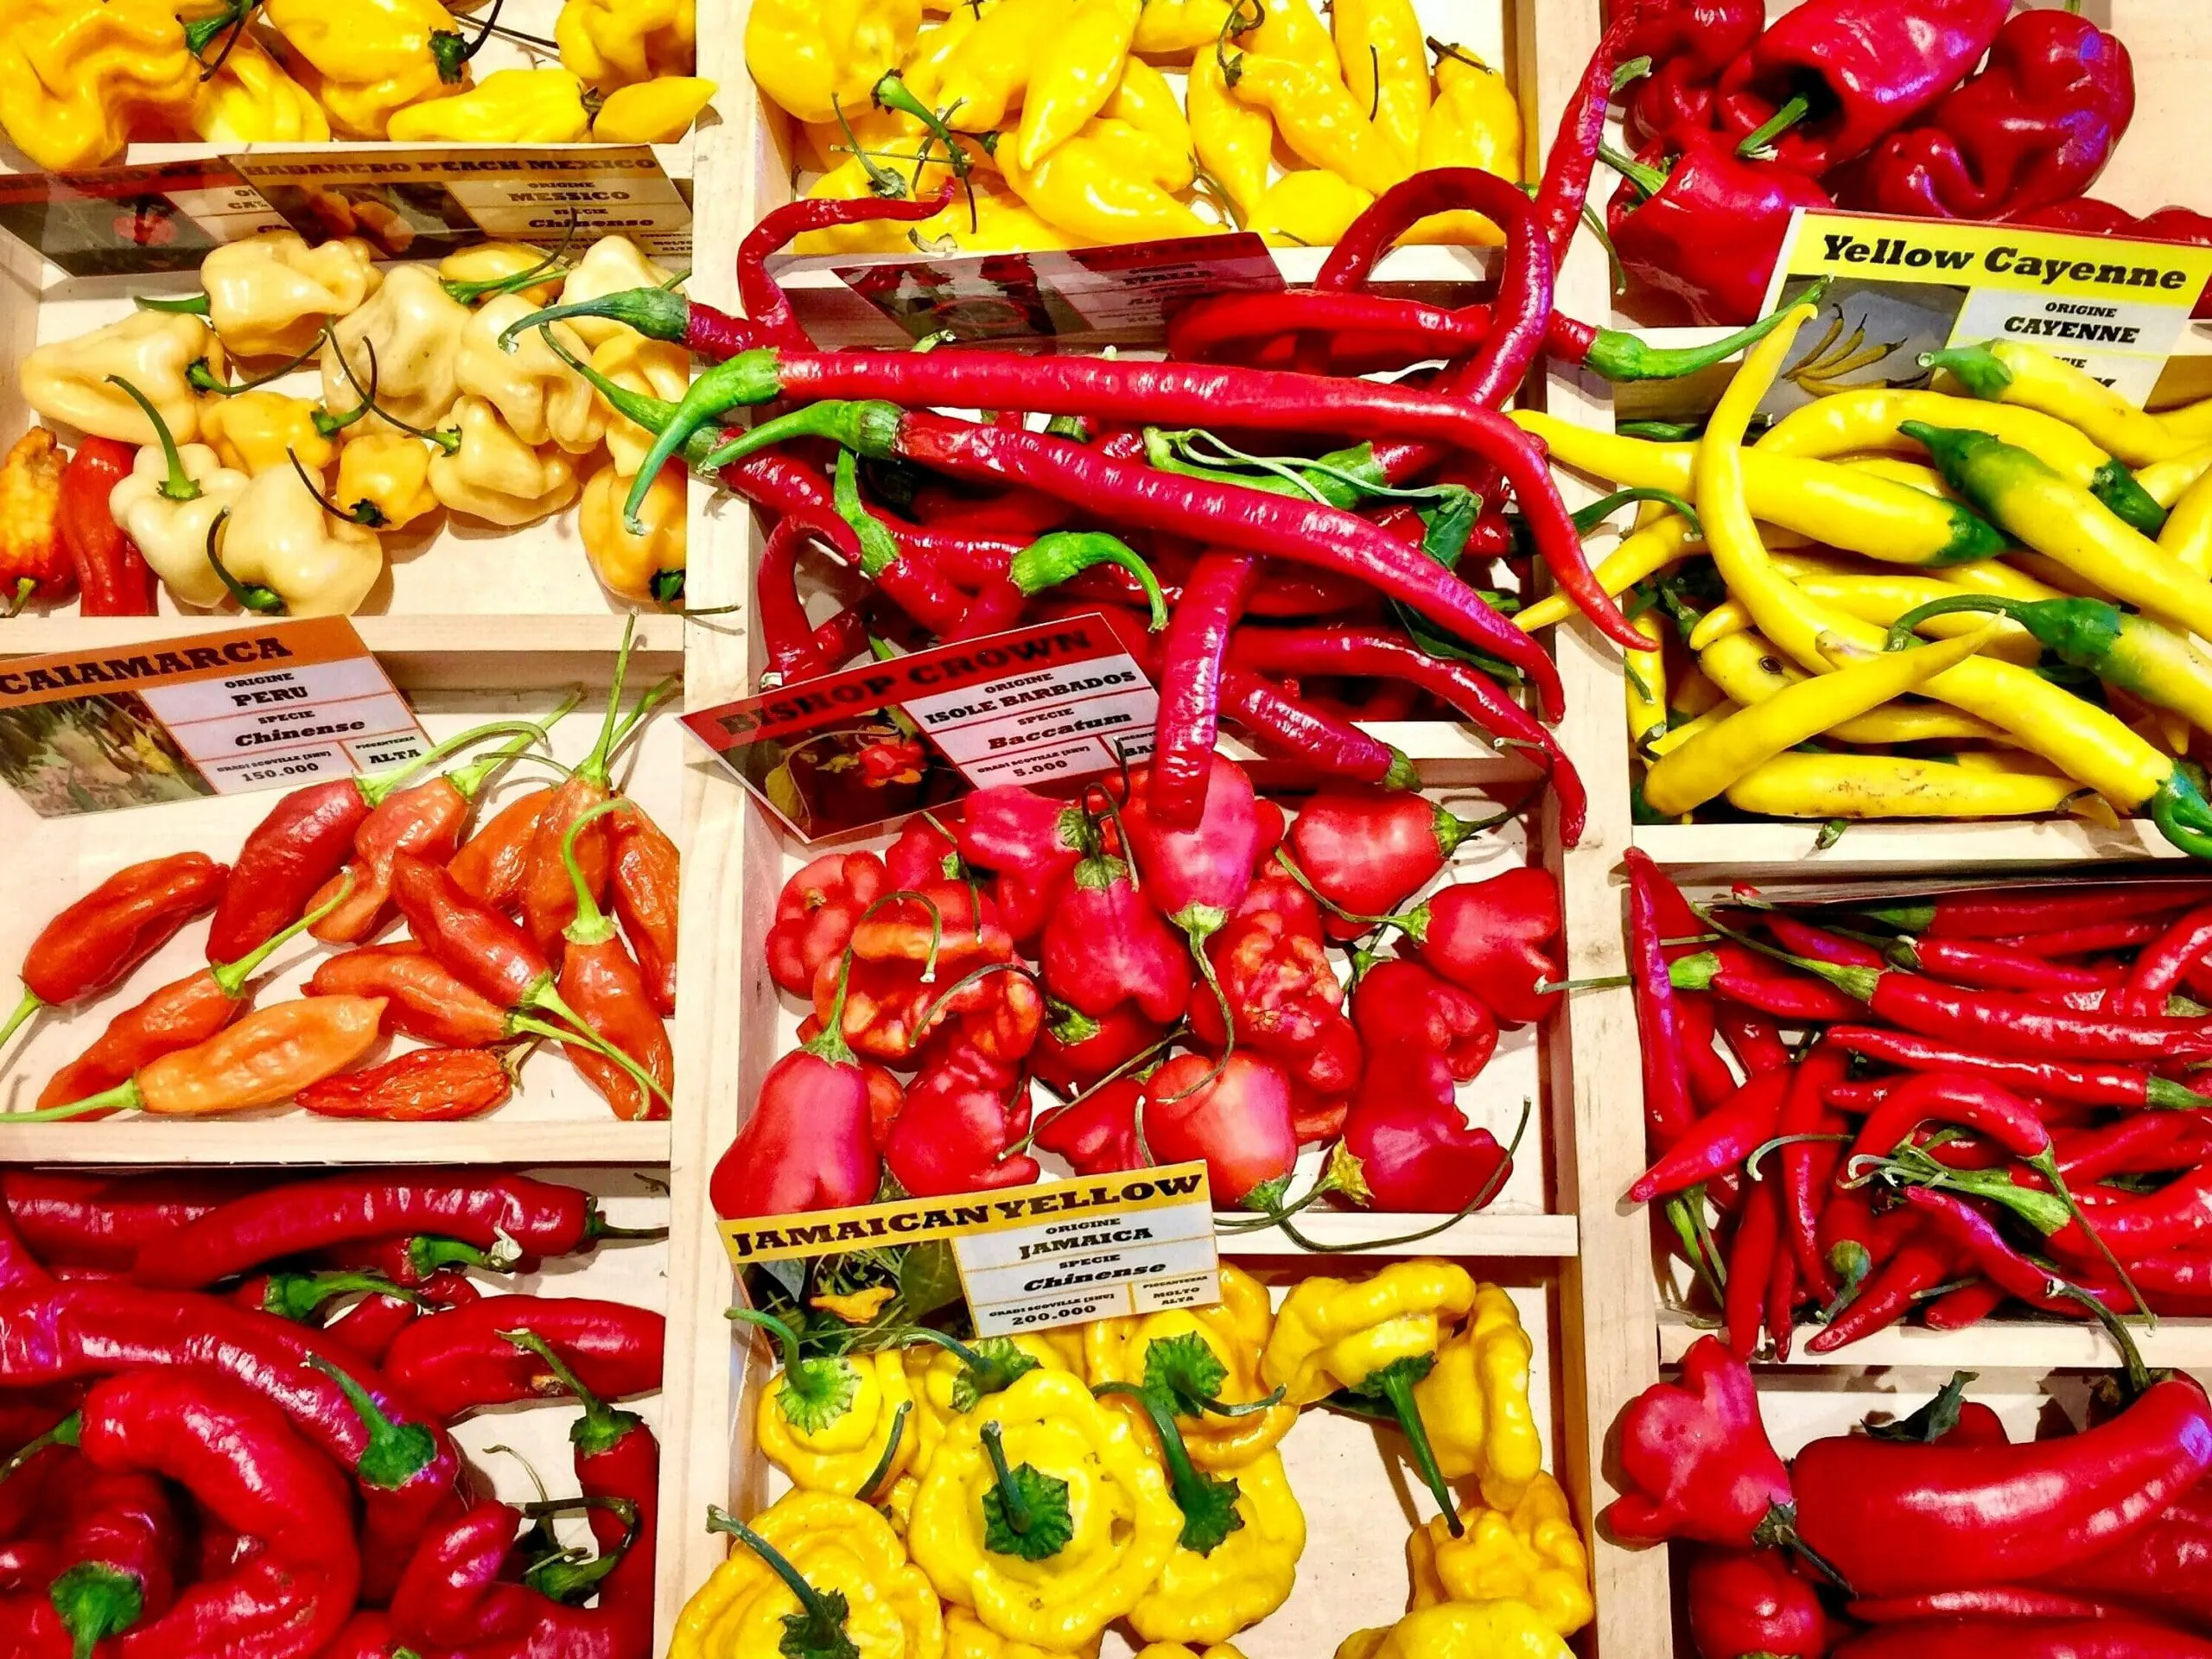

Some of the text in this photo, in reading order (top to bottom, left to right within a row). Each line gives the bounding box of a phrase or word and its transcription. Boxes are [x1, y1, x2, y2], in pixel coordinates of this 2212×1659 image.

[416, 160, 522, 171] PEACH
[525, 159, 657, 170] MEXICO
[508, 191, 630, 202] MESSICO
[1823, 234, 2187, 290] Yellow Cayenne
[2044, 302, 2118, 318] ORIGINE
[2003, 315, 2141, 344] CAYENNE
[0, 637, 293, 695] CAIAMARCA
[225, 672, 295, 689] ORIGINE
[716, 628, 1092, 735] BISHOP CROWN
[984, 671, 1054, 693] ORIGINE
[231, 686, 309, 707] PERU
[925, 671, 1137, 725] ISOLE BARBADOS
[257, 710, 315, 724] SPECIE
[1017, 707, 1075, 727] SPECIE
[235, 719, 365, 747] Chinense
[987, 711, 1133, 751] Baccatum
[369, 749, 422, 764] ALTA
[242, 762, 319, 782] 150.000
[1013, 760, 1068, 778] 5.000
[731, 1173, 1203, 1256] JAMAICAN YELLOW
[1046, 1217, 1122, 1235] ORIGINE
[1019, 1228, 1154, 1260] JAMAICA
[1058, 1254, 1122, 1269] SPECIE
[1023, 1263, 1166, 1293] Chinense
[1154, 1287, 1200, 1299] MOLTO
[1161, 1296, 1194, 1306] ALTA
[988, 1306, 1026, 1317] GRADI
[1027, 1298, 1081, 1312] SCOVILLE
[1012, 1305, 1096, 1326] 200.000
